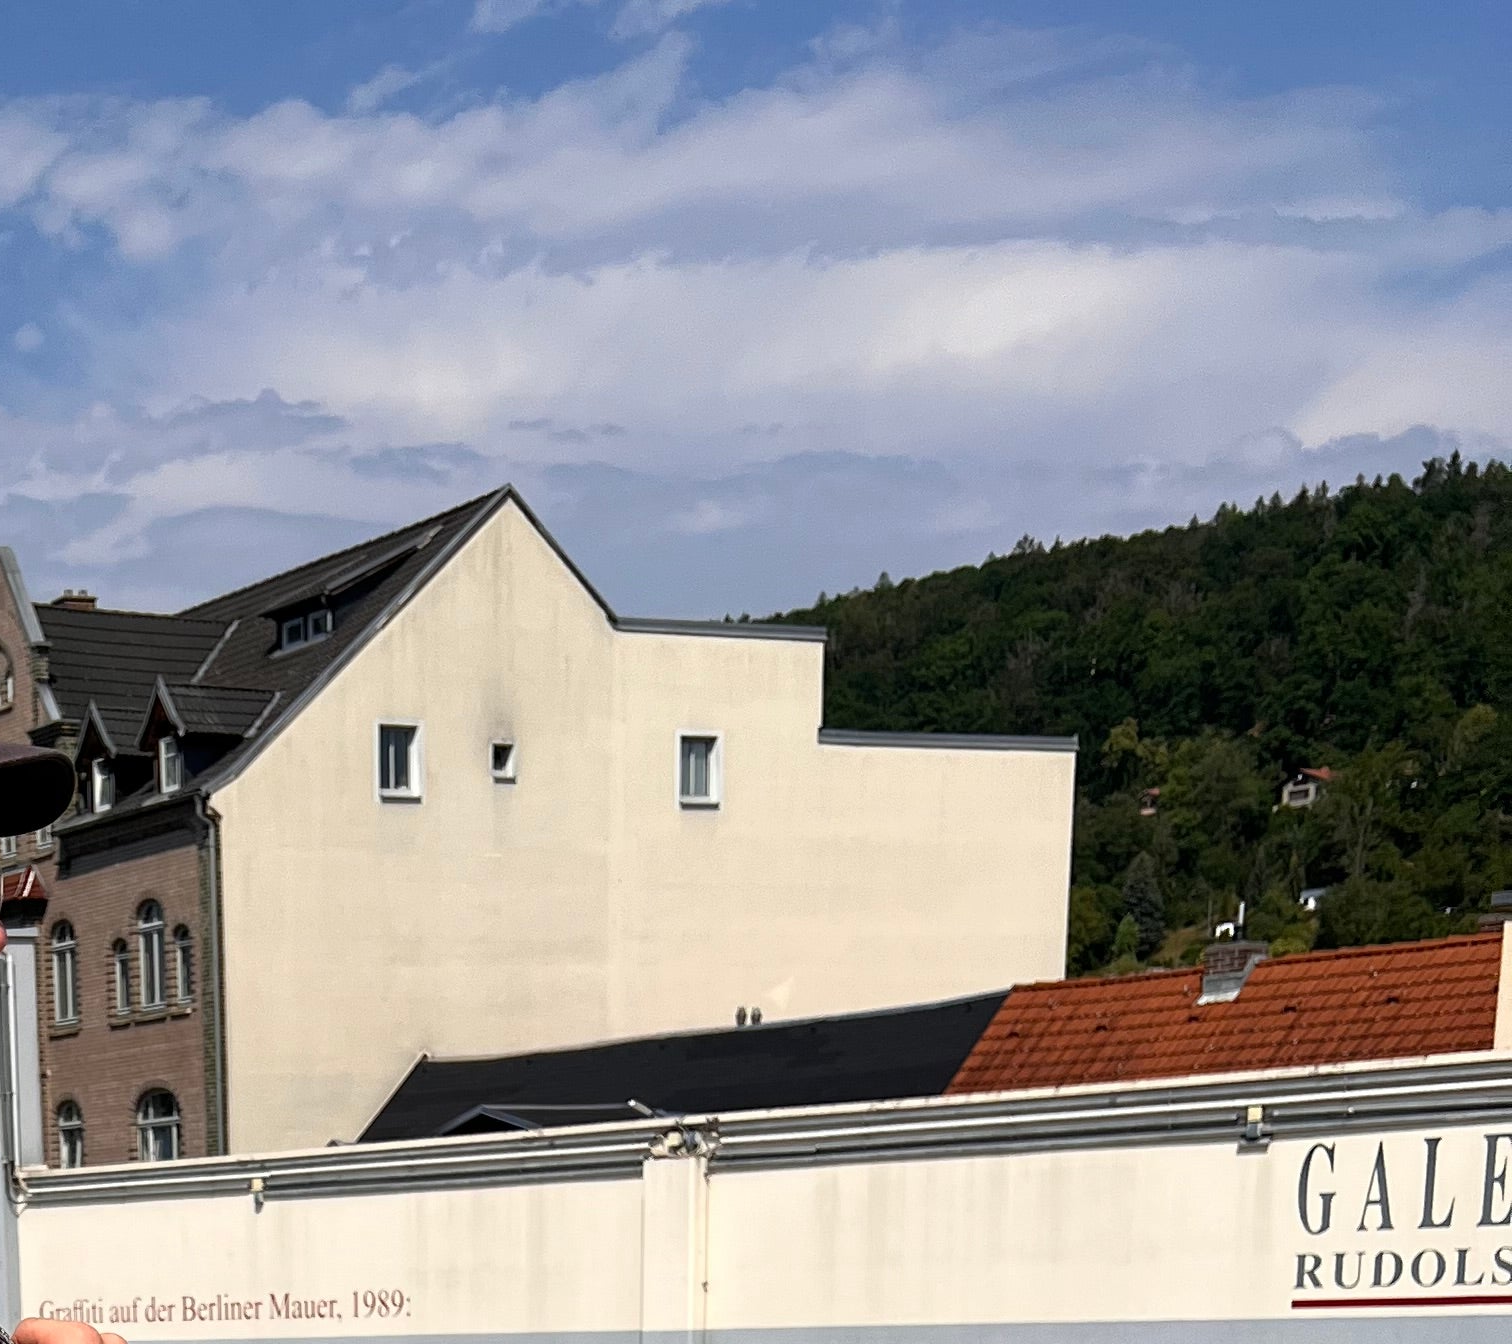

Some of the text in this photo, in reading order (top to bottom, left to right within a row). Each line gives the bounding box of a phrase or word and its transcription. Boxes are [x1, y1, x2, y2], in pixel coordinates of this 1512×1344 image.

[1297, 1134, 1512, 1236] GALE
[1293, 1246, 1512, 1290] RUDOLS
[109, 1296, 142, 1323] auf
[144, 1296, 177, 1323] der
[181, 1293, 264, 1322] Berliner
[269, 1292, 343, 1323] Mauer,
[351, 1289, 413, 1320] 1989:
